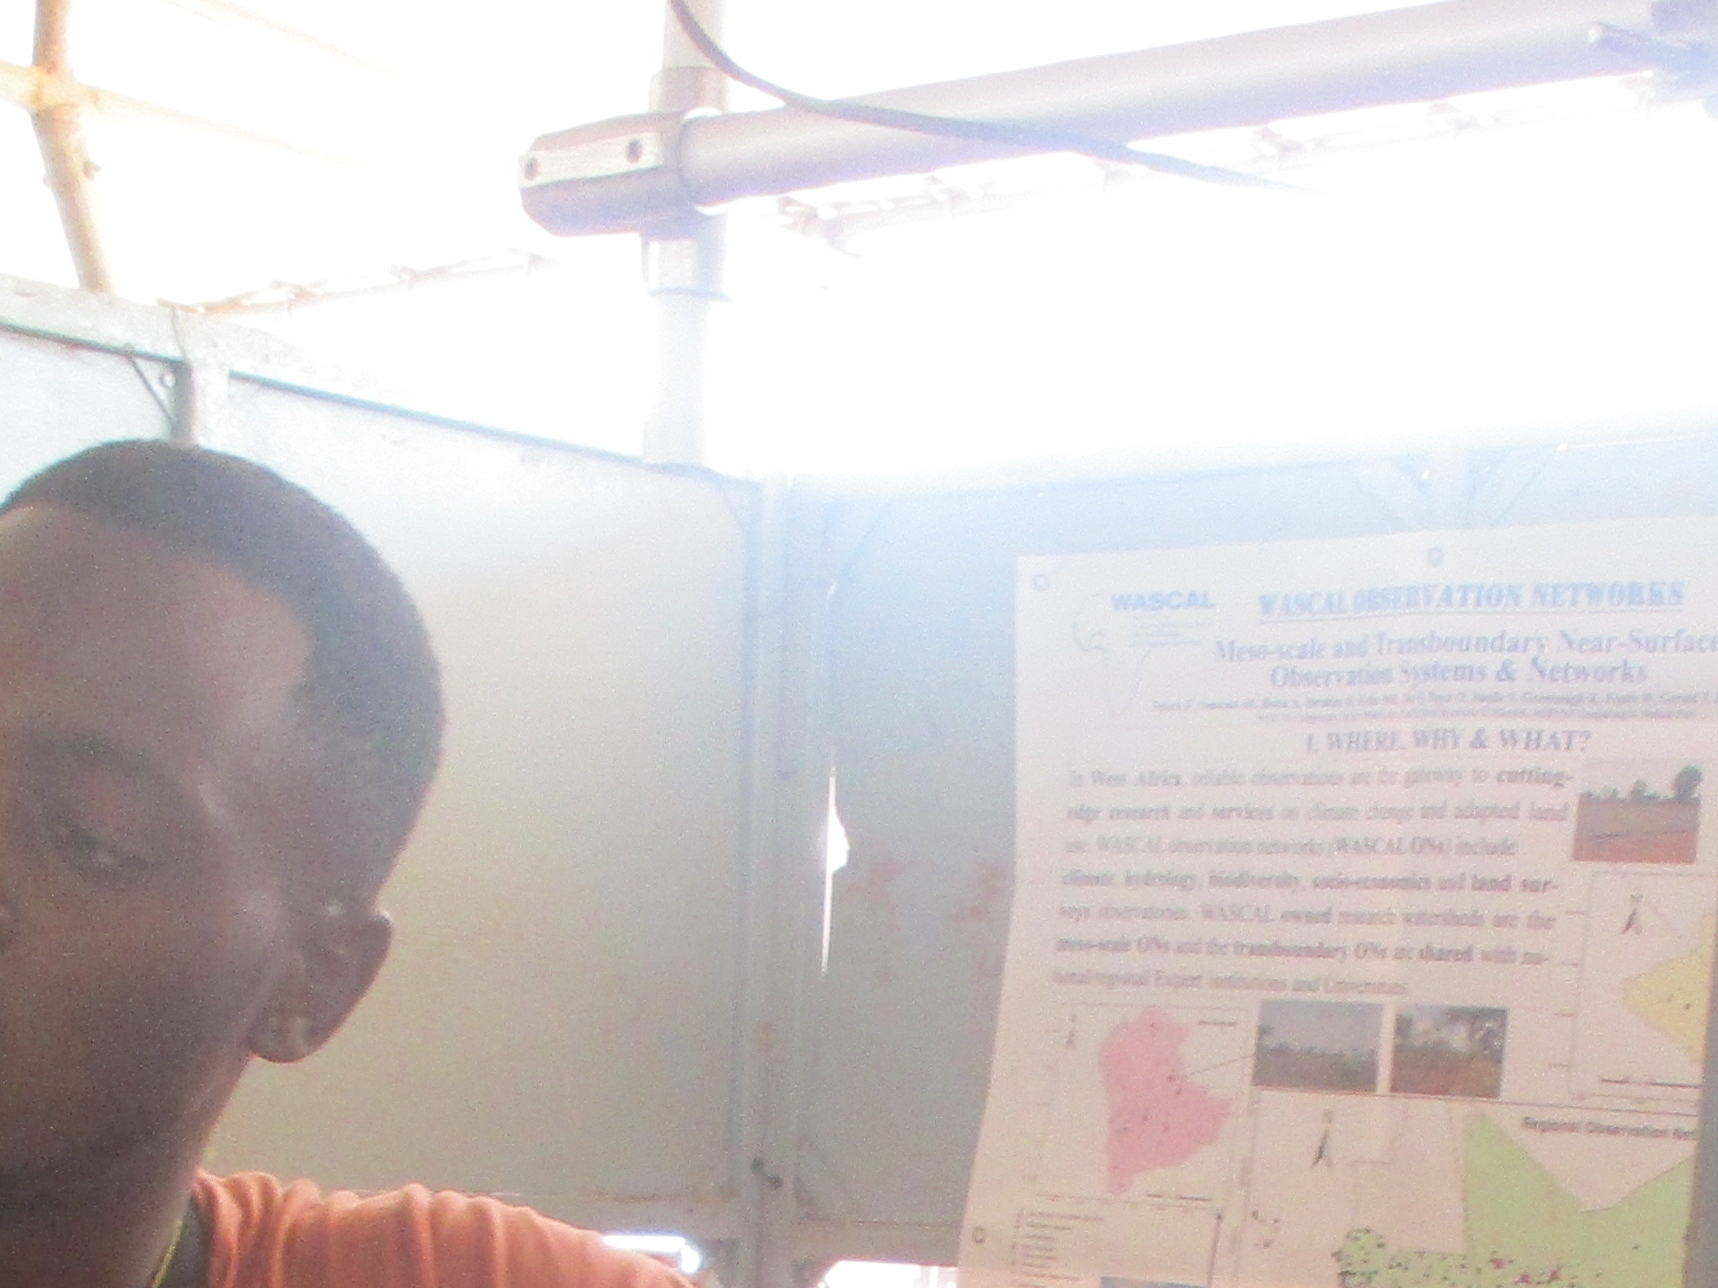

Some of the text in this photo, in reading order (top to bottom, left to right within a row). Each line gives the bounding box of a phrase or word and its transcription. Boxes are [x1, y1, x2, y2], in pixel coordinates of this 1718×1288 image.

[1111, 591, 1216, 612] WASCAL
[1259, 580, 1685, 618] WASCAL OBSERVATION NETWORKS
[1216, 638, 1325, 662] Meso-scale
[1333, 636, 1368, 659] and
[1376, 630, 1546, 659] Transboundary
[1270, 656, 1648, 689] Observation Systems & Networks
[1414, 729, 1460, 752] WHY
[1469, 730, 1489, 751] &
[1498, 730, 1593, 753] WHAT?
